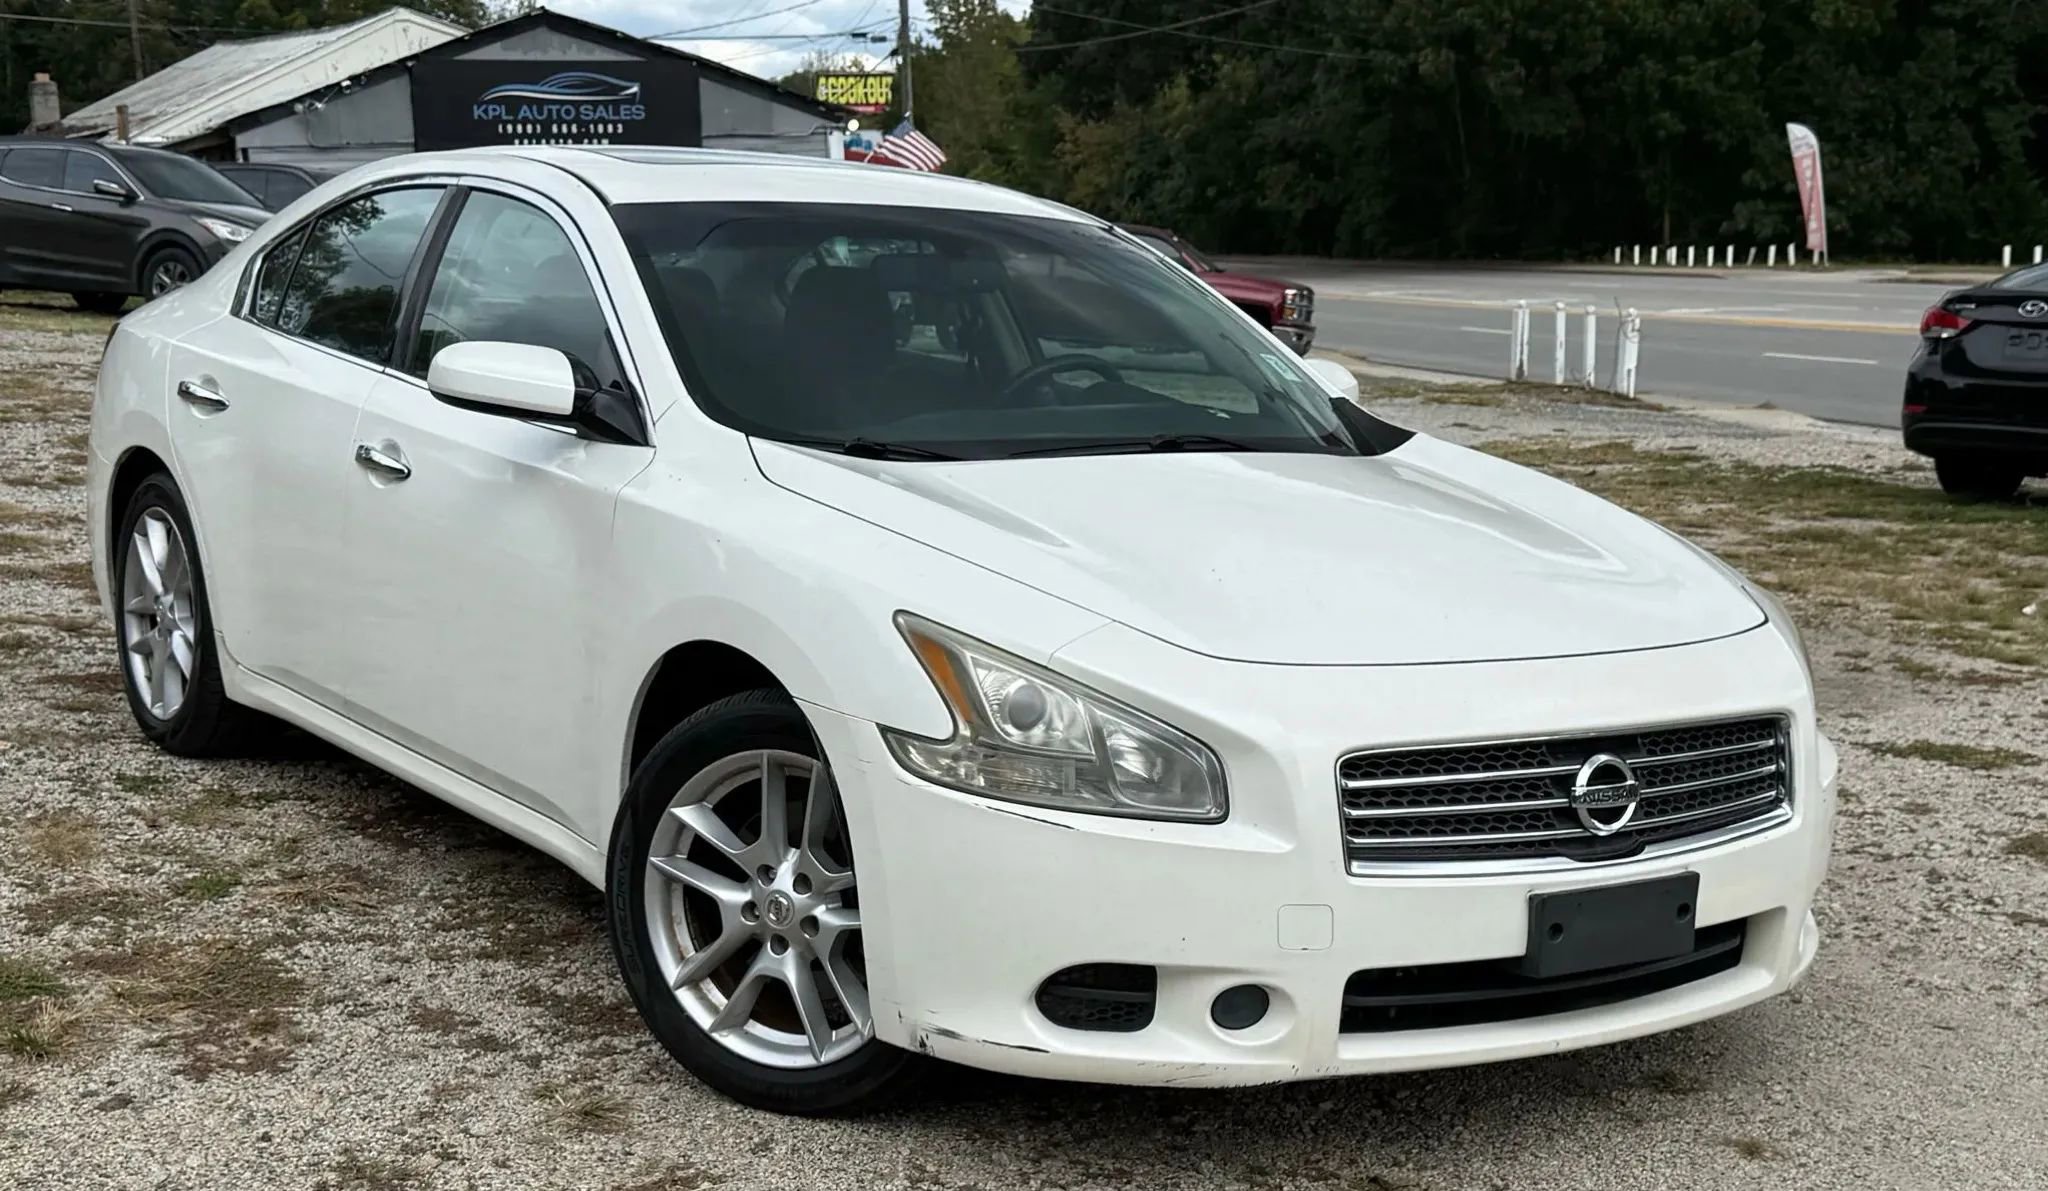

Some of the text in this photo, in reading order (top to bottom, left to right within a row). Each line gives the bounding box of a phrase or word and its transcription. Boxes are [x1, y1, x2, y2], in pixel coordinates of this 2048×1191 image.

[473, 104, 645, 120] KPL AUTO SALES
